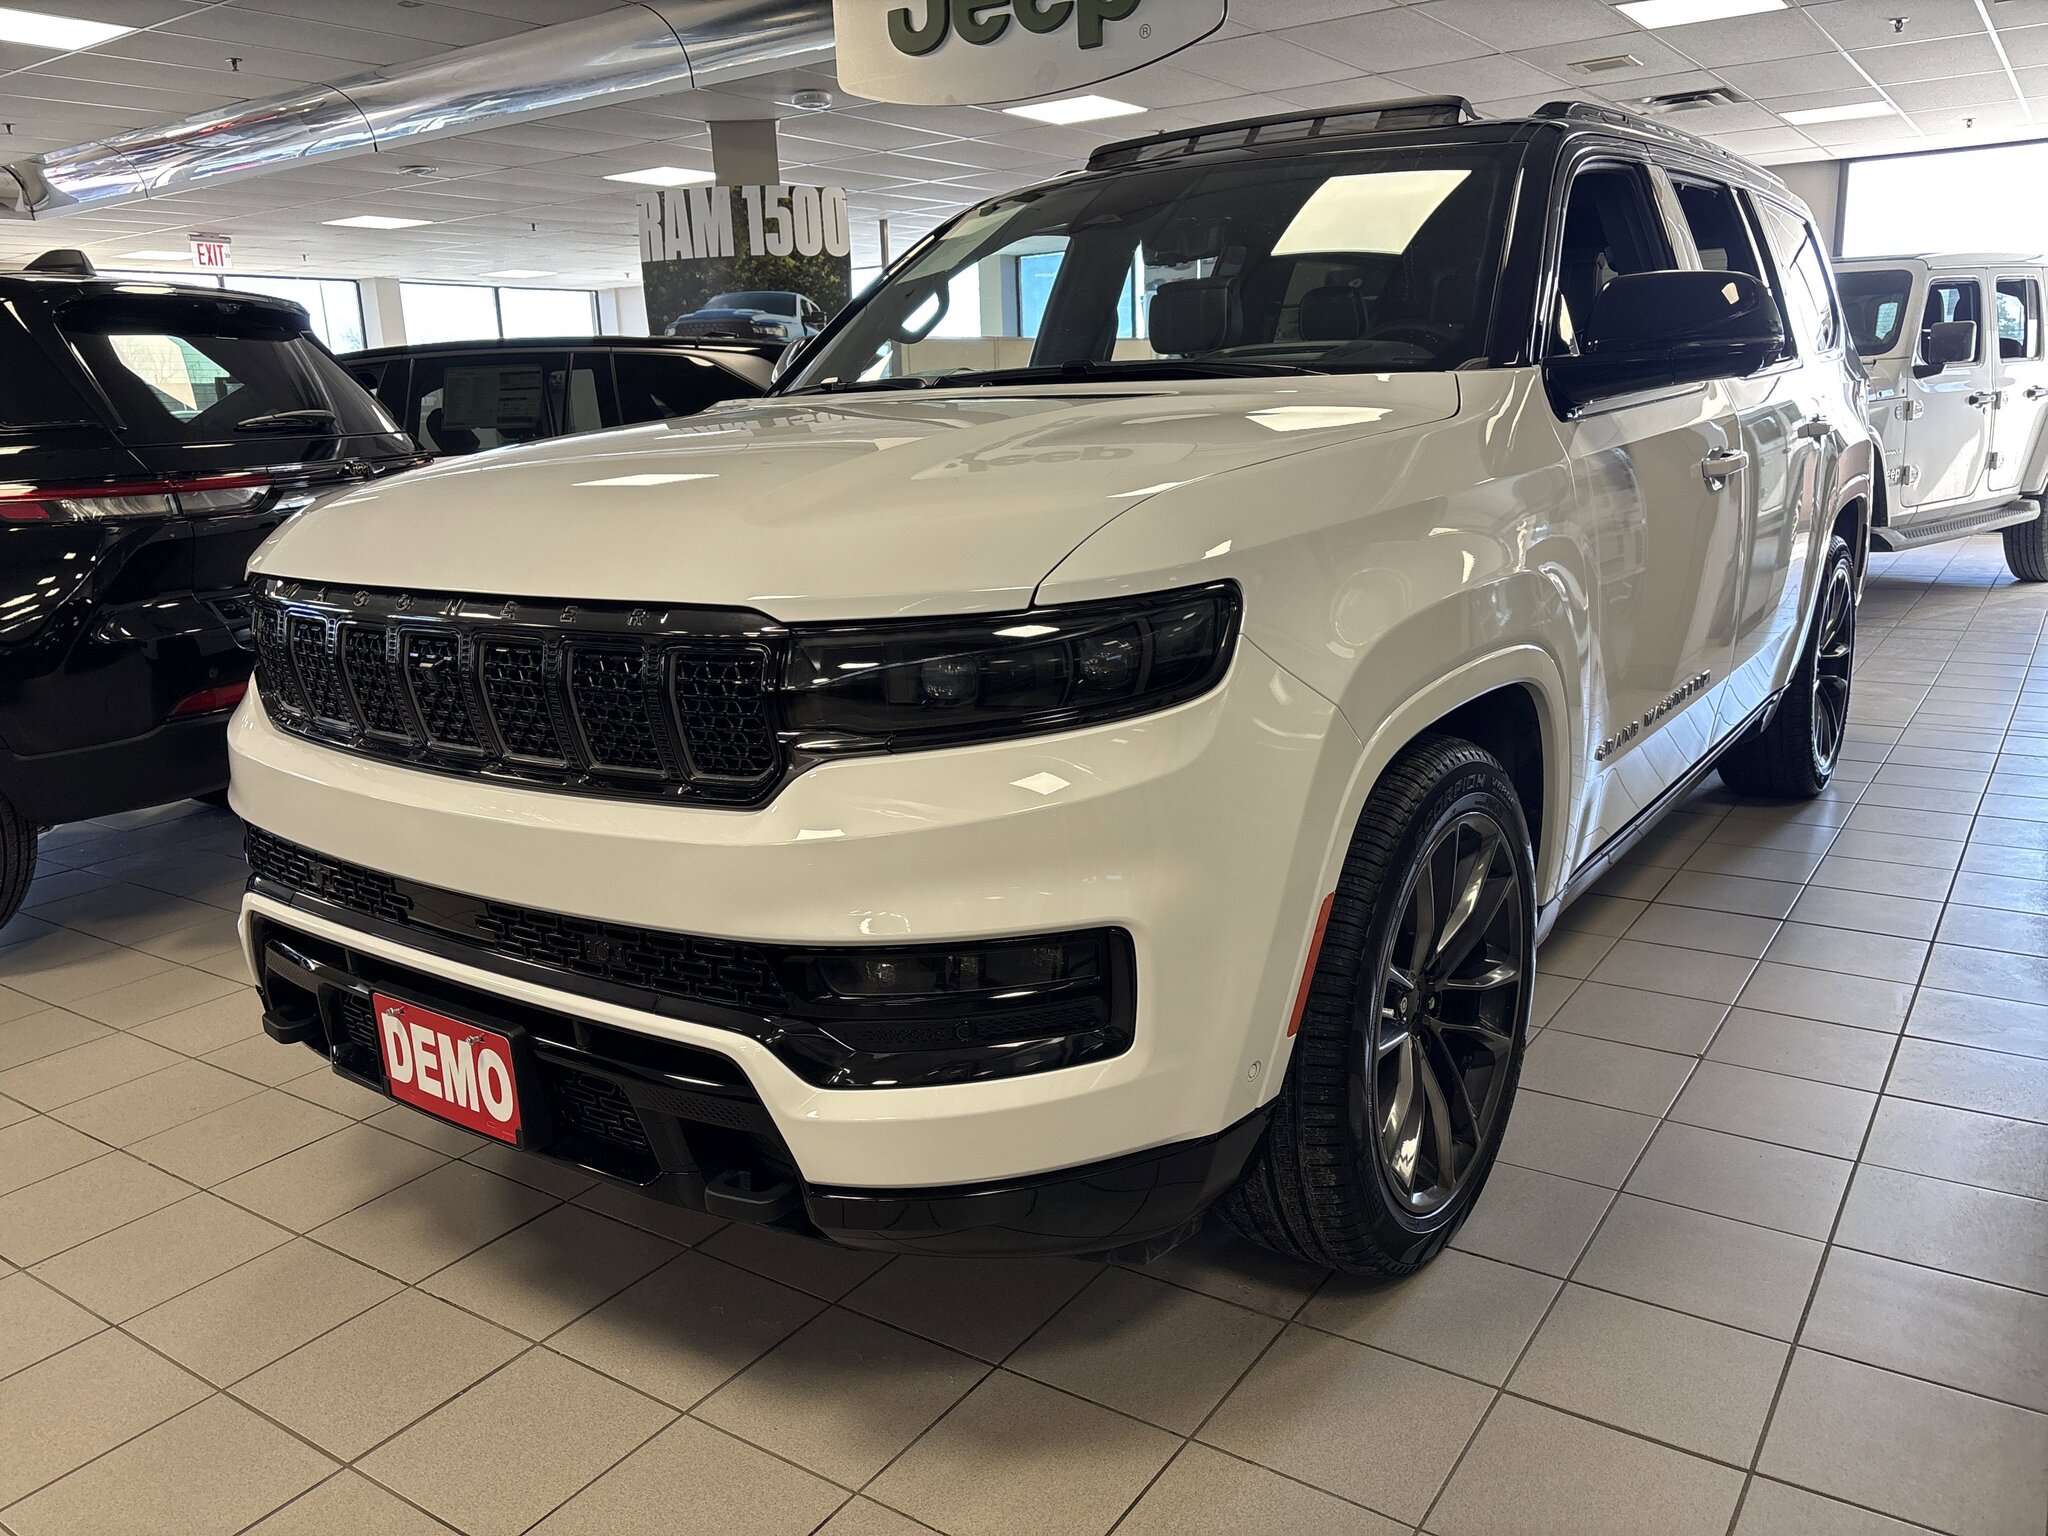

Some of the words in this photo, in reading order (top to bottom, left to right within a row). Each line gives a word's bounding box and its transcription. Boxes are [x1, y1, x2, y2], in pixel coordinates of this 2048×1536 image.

[888, 0, 1141, 55] Jeep
[637, 186, 735, 262] RAM
[742, 186, 850, 258] 1500
[197, 243, 224, 266] EXIT
[1886, 468, 1901, 481] eep
[276, 583, 650, 627] WAGONEER
[381, 1012, 513, 1122] DEMO
